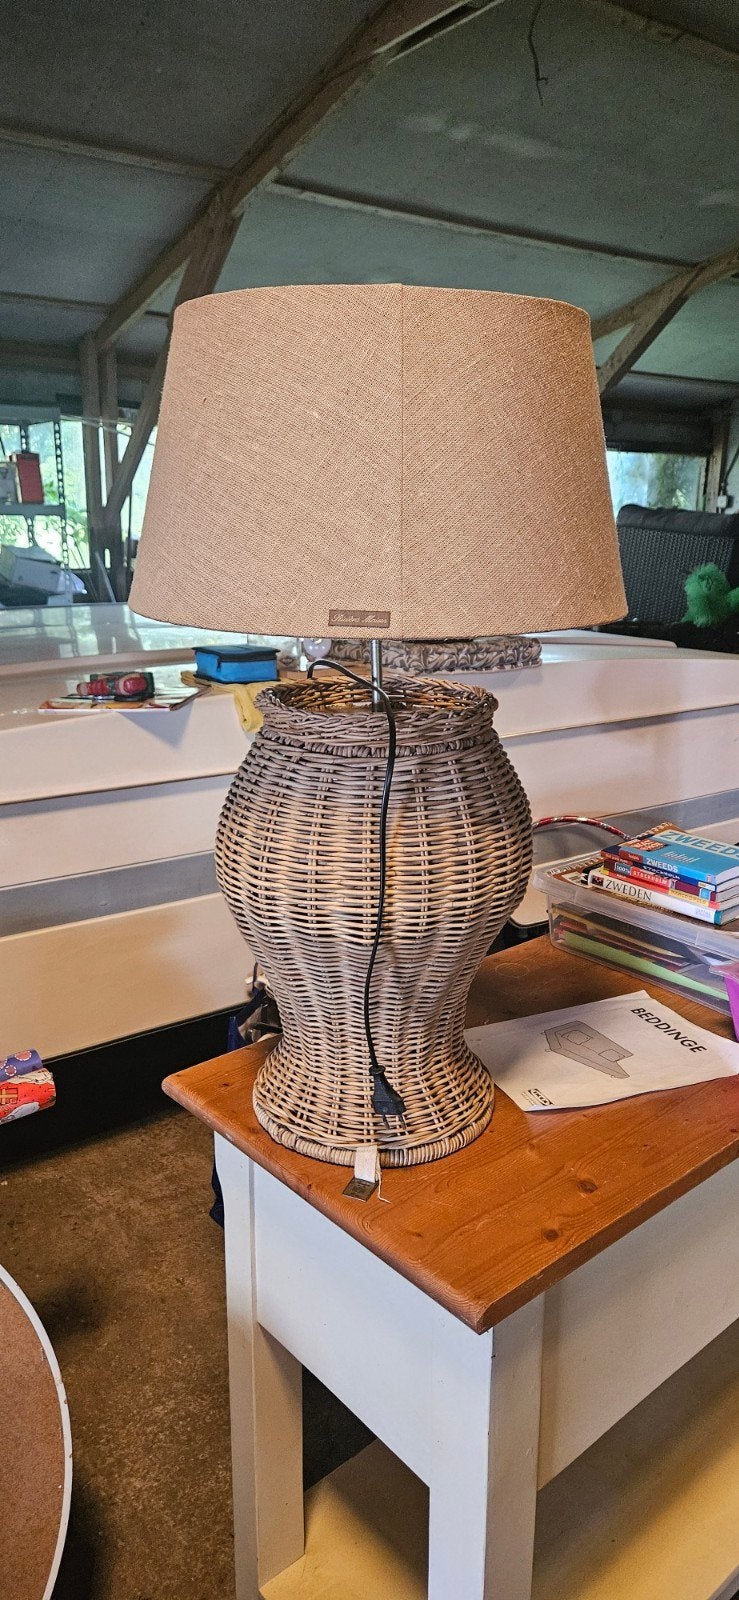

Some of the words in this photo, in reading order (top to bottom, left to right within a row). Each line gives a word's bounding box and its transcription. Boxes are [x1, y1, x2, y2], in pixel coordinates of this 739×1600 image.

[660, 831, 739, 858] ZWEED
[646, 857, 678, 873] ZWEEDS
[633, 870, 668, 885] STOCKHOLM
[606, 879, 652, 901] ZWEDEN
[630, 1007, 707, 1054] BEDDINGE
